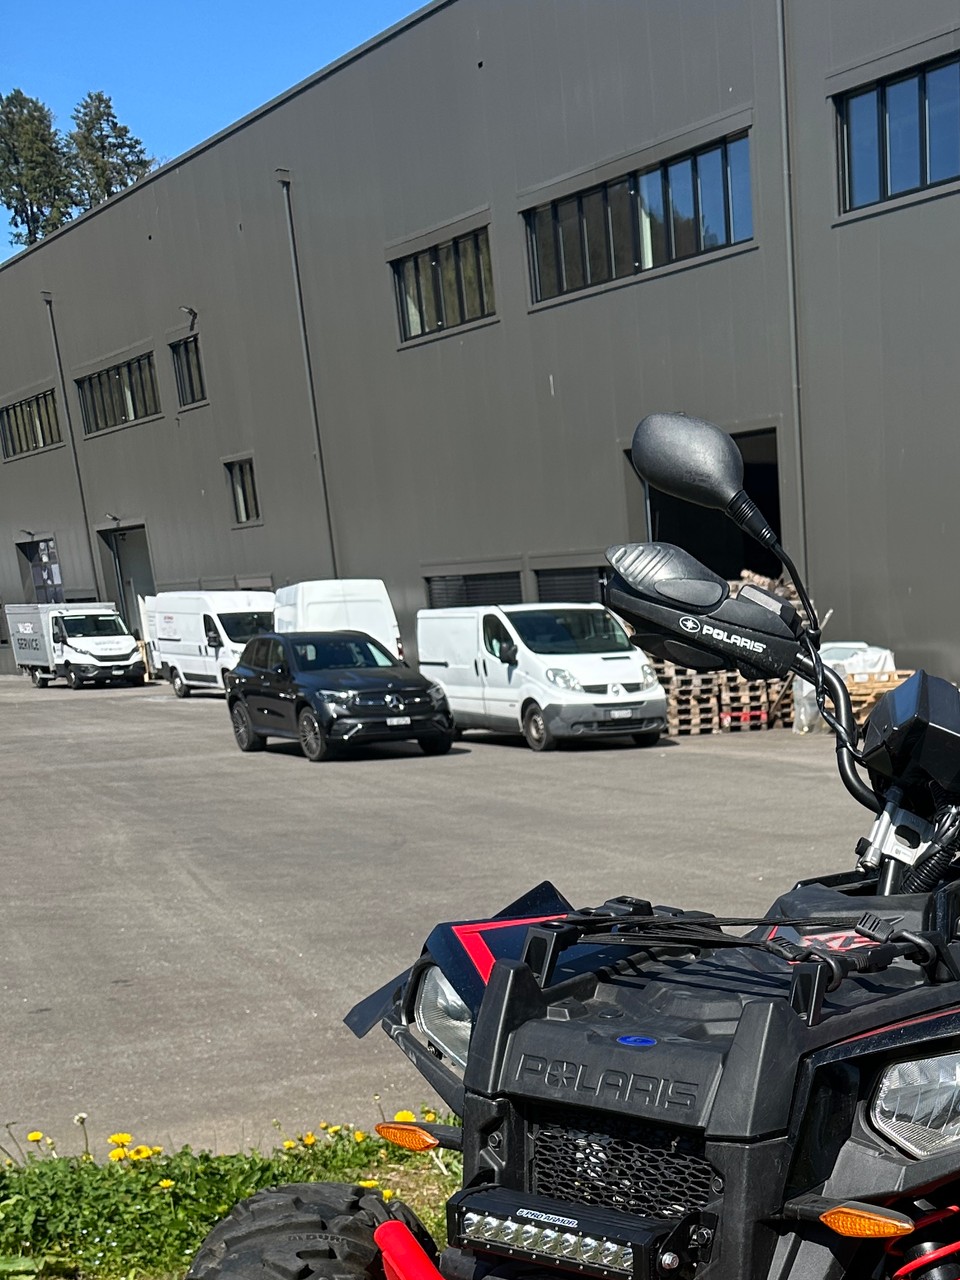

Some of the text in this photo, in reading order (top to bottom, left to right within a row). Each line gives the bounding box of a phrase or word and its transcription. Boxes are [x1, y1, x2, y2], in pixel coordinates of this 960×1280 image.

[701, 625, 766, 653] POLARIS
[515, 1053, 700, 1110] POLARIS
[524, 1210, 577, 1227] PRO ARMOR
